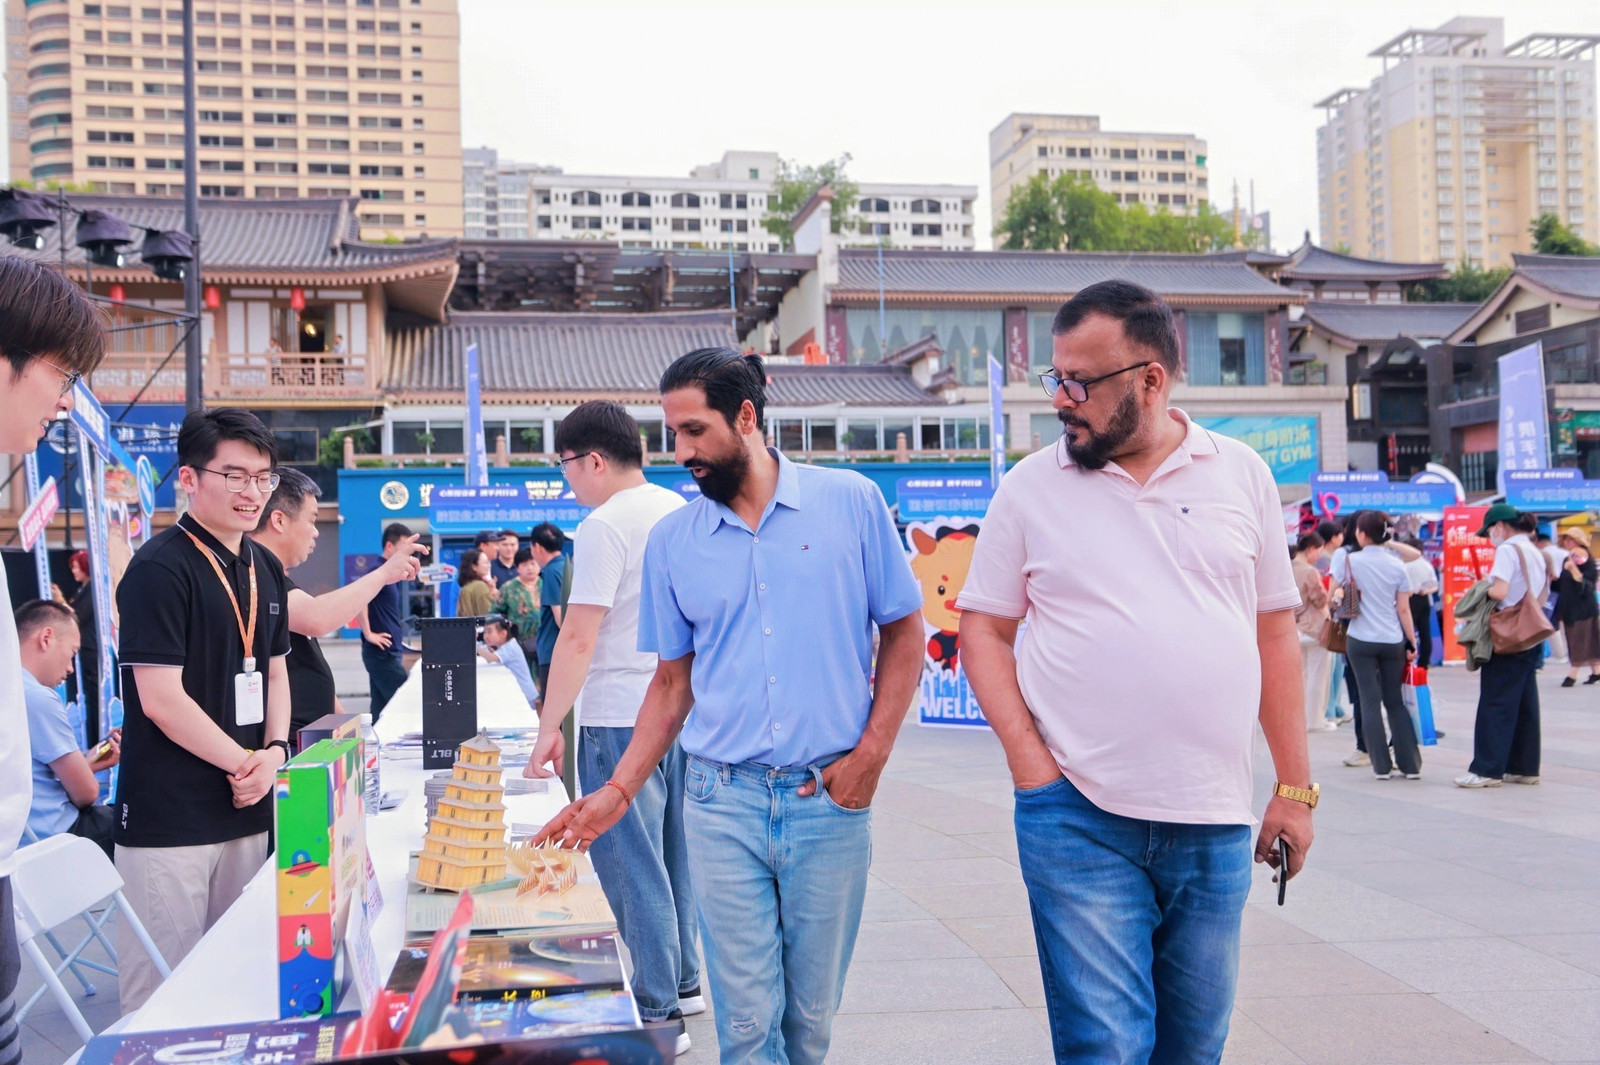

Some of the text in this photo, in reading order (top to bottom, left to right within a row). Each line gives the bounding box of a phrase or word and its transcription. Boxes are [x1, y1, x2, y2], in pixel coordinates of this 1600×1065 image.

[1234, 424, 1311, 451] 健身游泳
[1281, 445, 1311, 464] GYM
[431, 749, 453, 759] BLT
[121, 803, 129, 829] BLT
